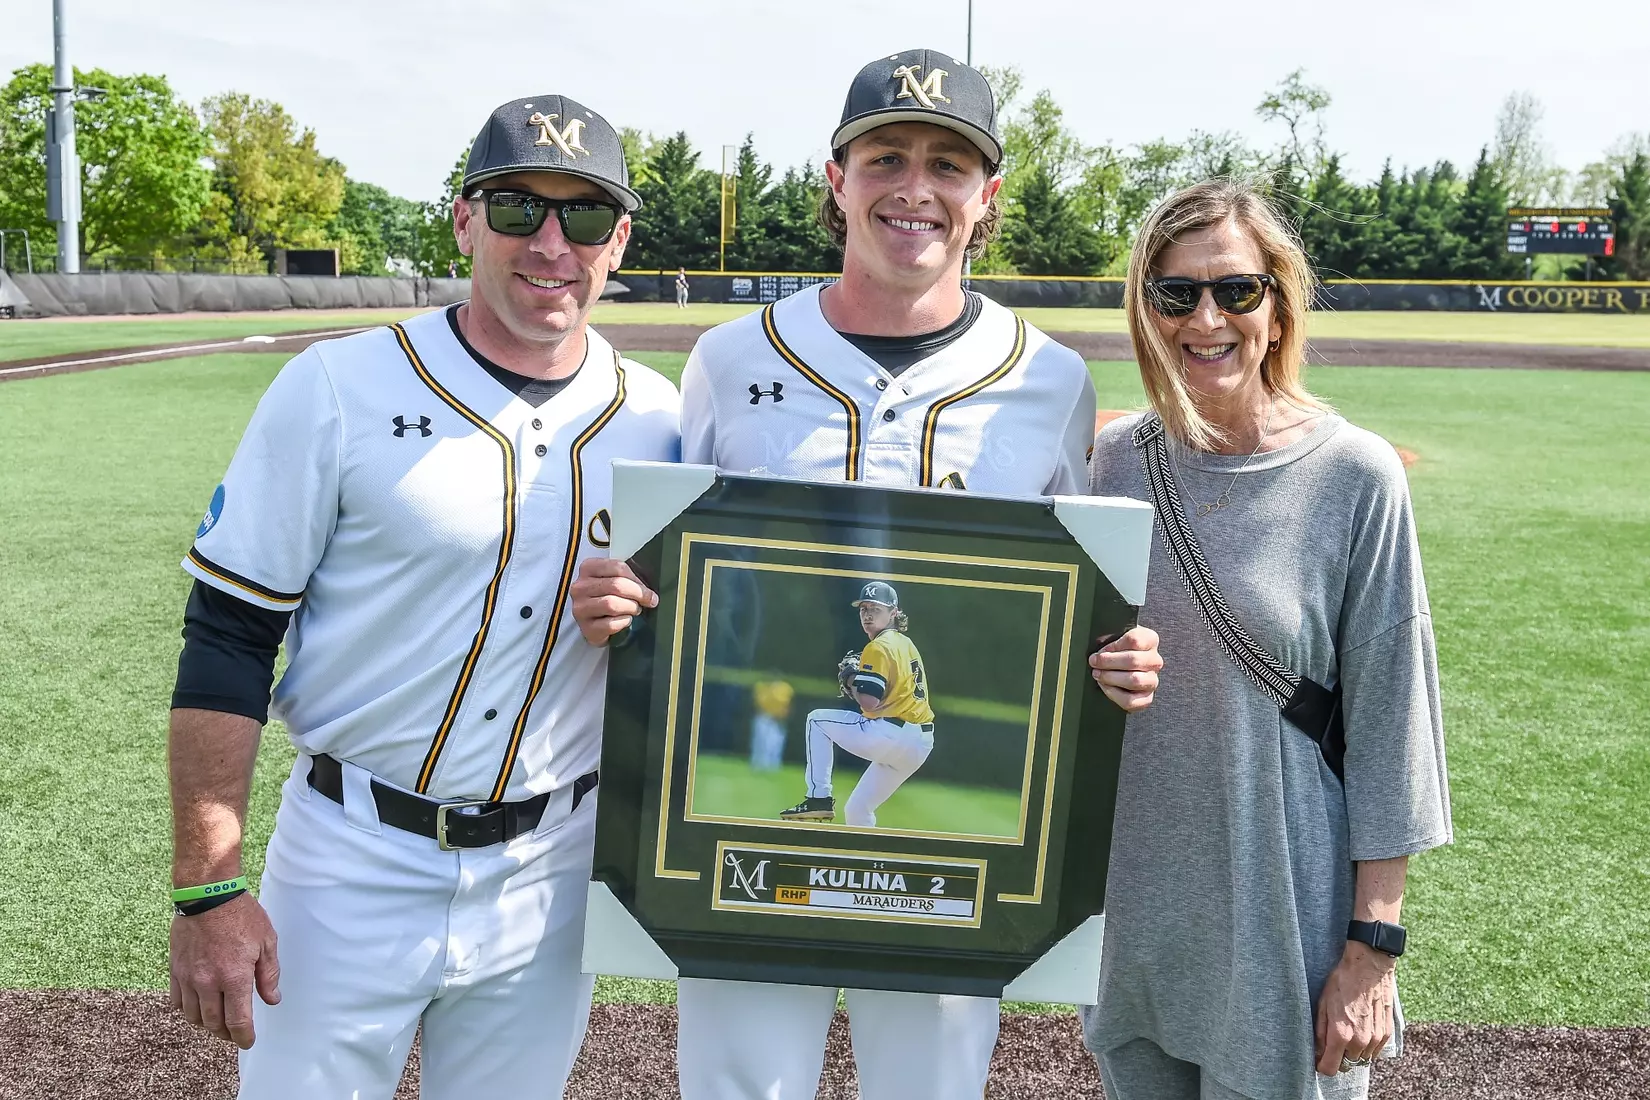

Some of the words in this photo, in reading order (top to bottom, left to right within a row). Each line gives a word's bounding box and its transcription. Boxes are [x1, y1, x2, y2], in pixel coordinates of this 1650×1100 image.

[1507, 287, 1632, 313] COOPER
[809, 868, 907, 892] KULINA
[930, 876, 945, 894] 2
[781, 889, 807, 899] RHP
[852, 894, 934, 911] MARAUDERS
